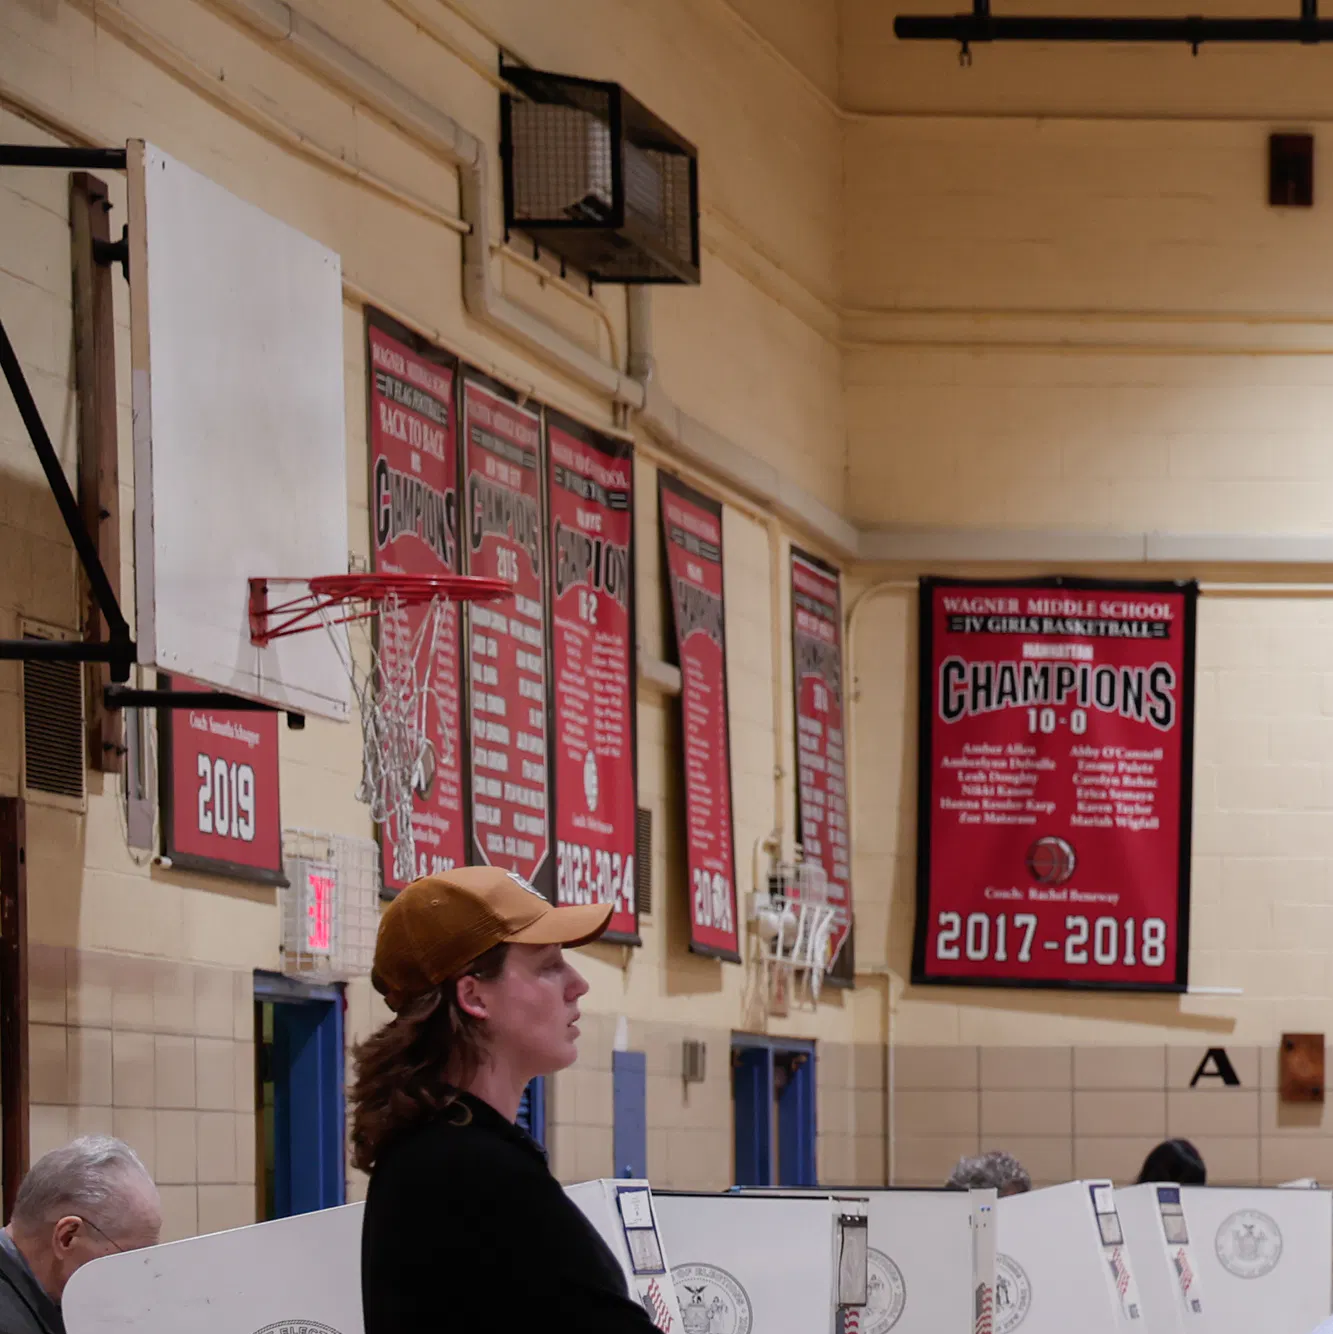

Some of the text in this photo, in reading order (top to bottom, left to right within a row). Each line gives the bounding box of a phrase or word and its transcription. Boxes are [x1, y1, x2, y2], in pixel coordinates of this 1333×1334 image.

[380, 403, 408, 440] BACK
[408, 416, 421, 446] TO
[943, 597, 1174, 620] WAGNER MIDDLE SCHOOL
[965, 617, 1151, 637] JV GIRLS BASKETBALL
[939, 655, 1176, 731] CHAMPIONS
[189, 710, 208, 731] Coach
[197, 753, 255, 842] 2019
[1189, 1047, 1240, 1088] A
